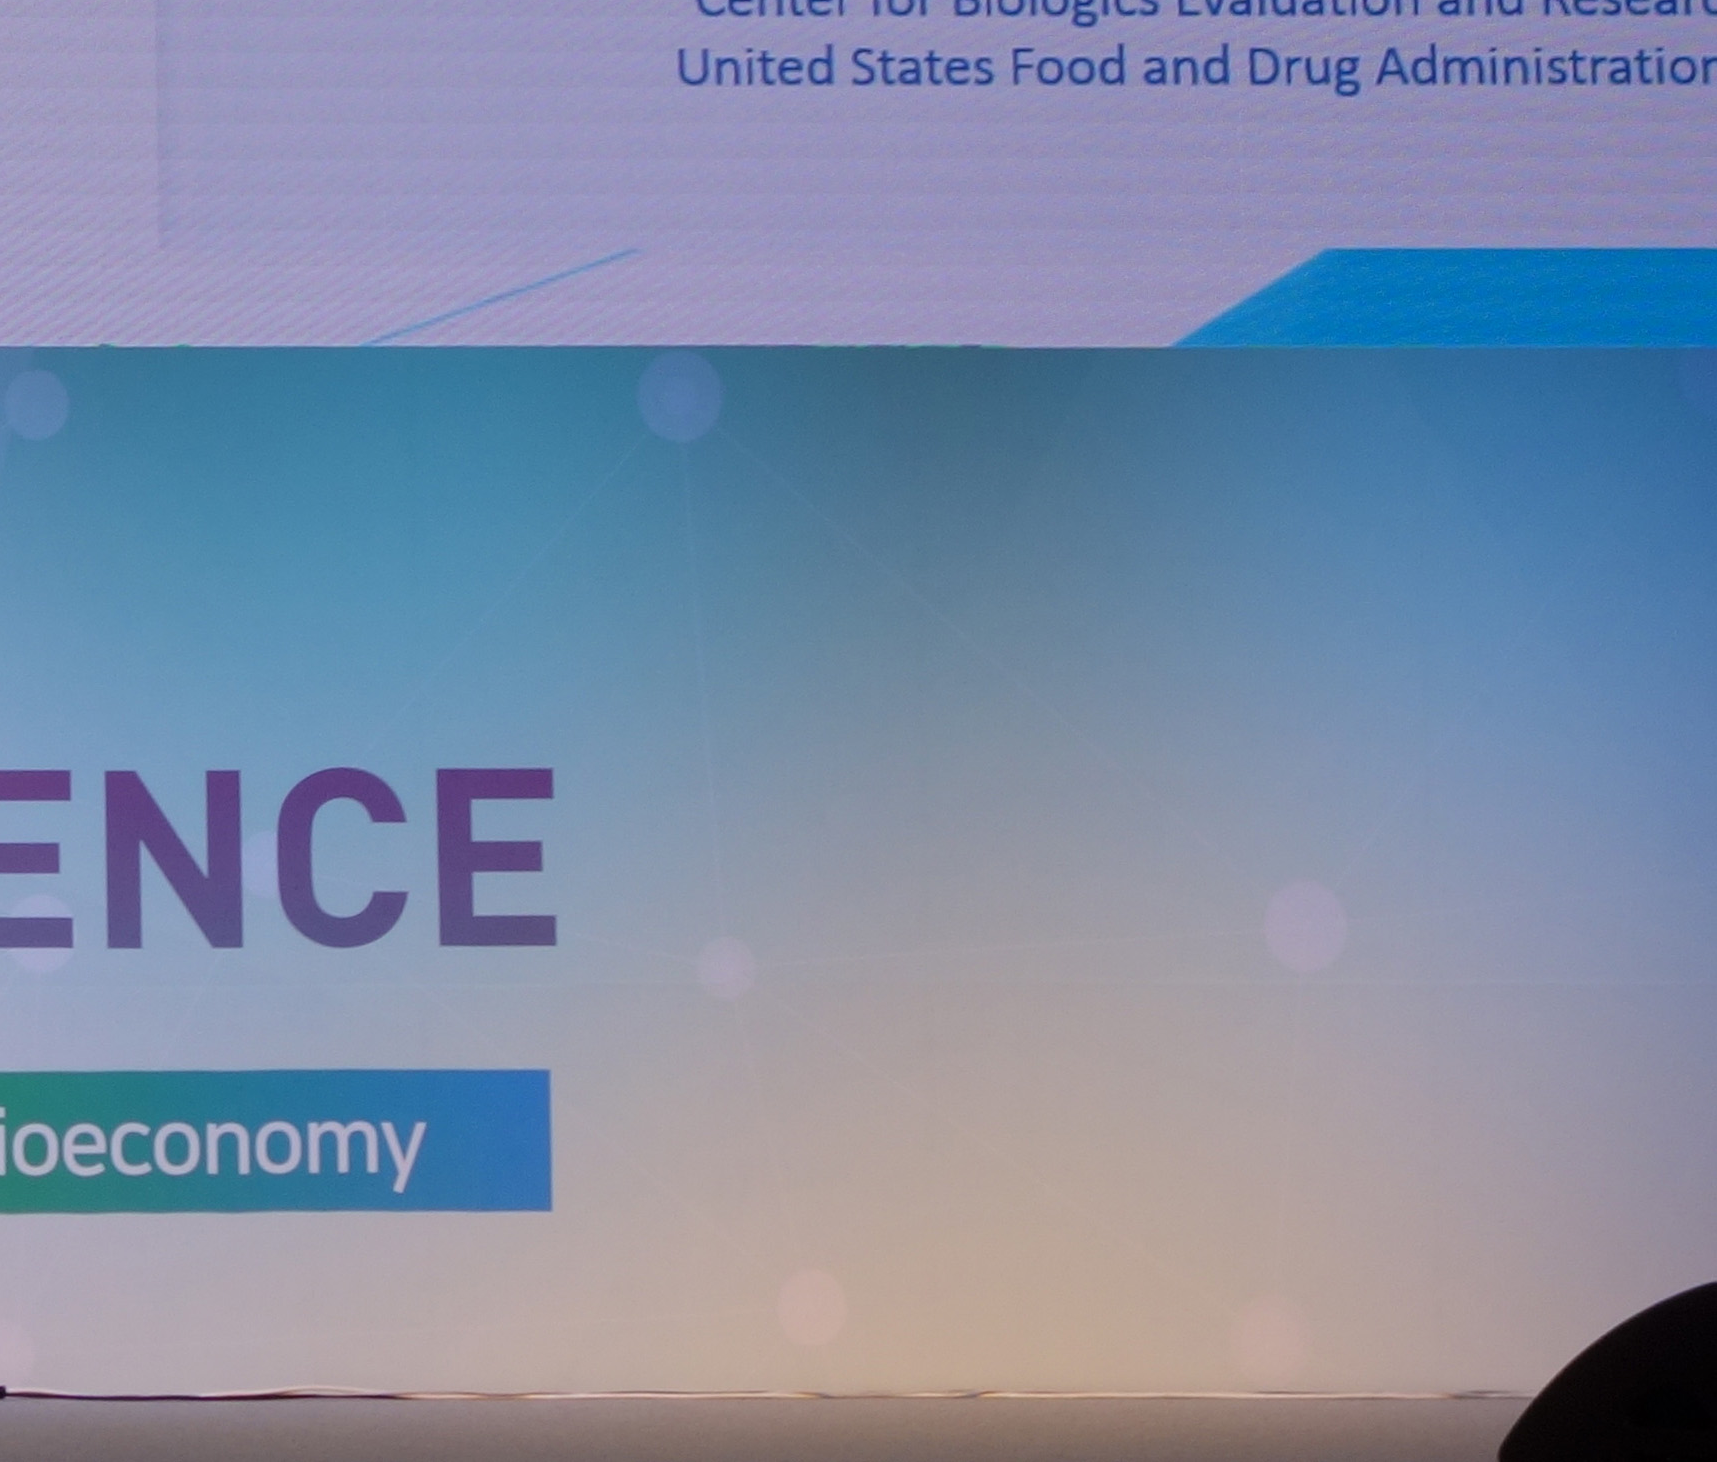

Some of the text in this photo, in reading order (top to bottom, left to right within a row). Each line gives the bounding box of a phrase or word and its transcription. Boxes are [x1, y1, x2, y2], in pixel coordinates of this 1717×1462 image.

[679, 45, 834, 86] United
[853, 48, 995, 86] States
[1013, 44, 1126, 86] Food
[1144, 44, 1230, 85] and
[1249, 47, 1361, 97] Drug
